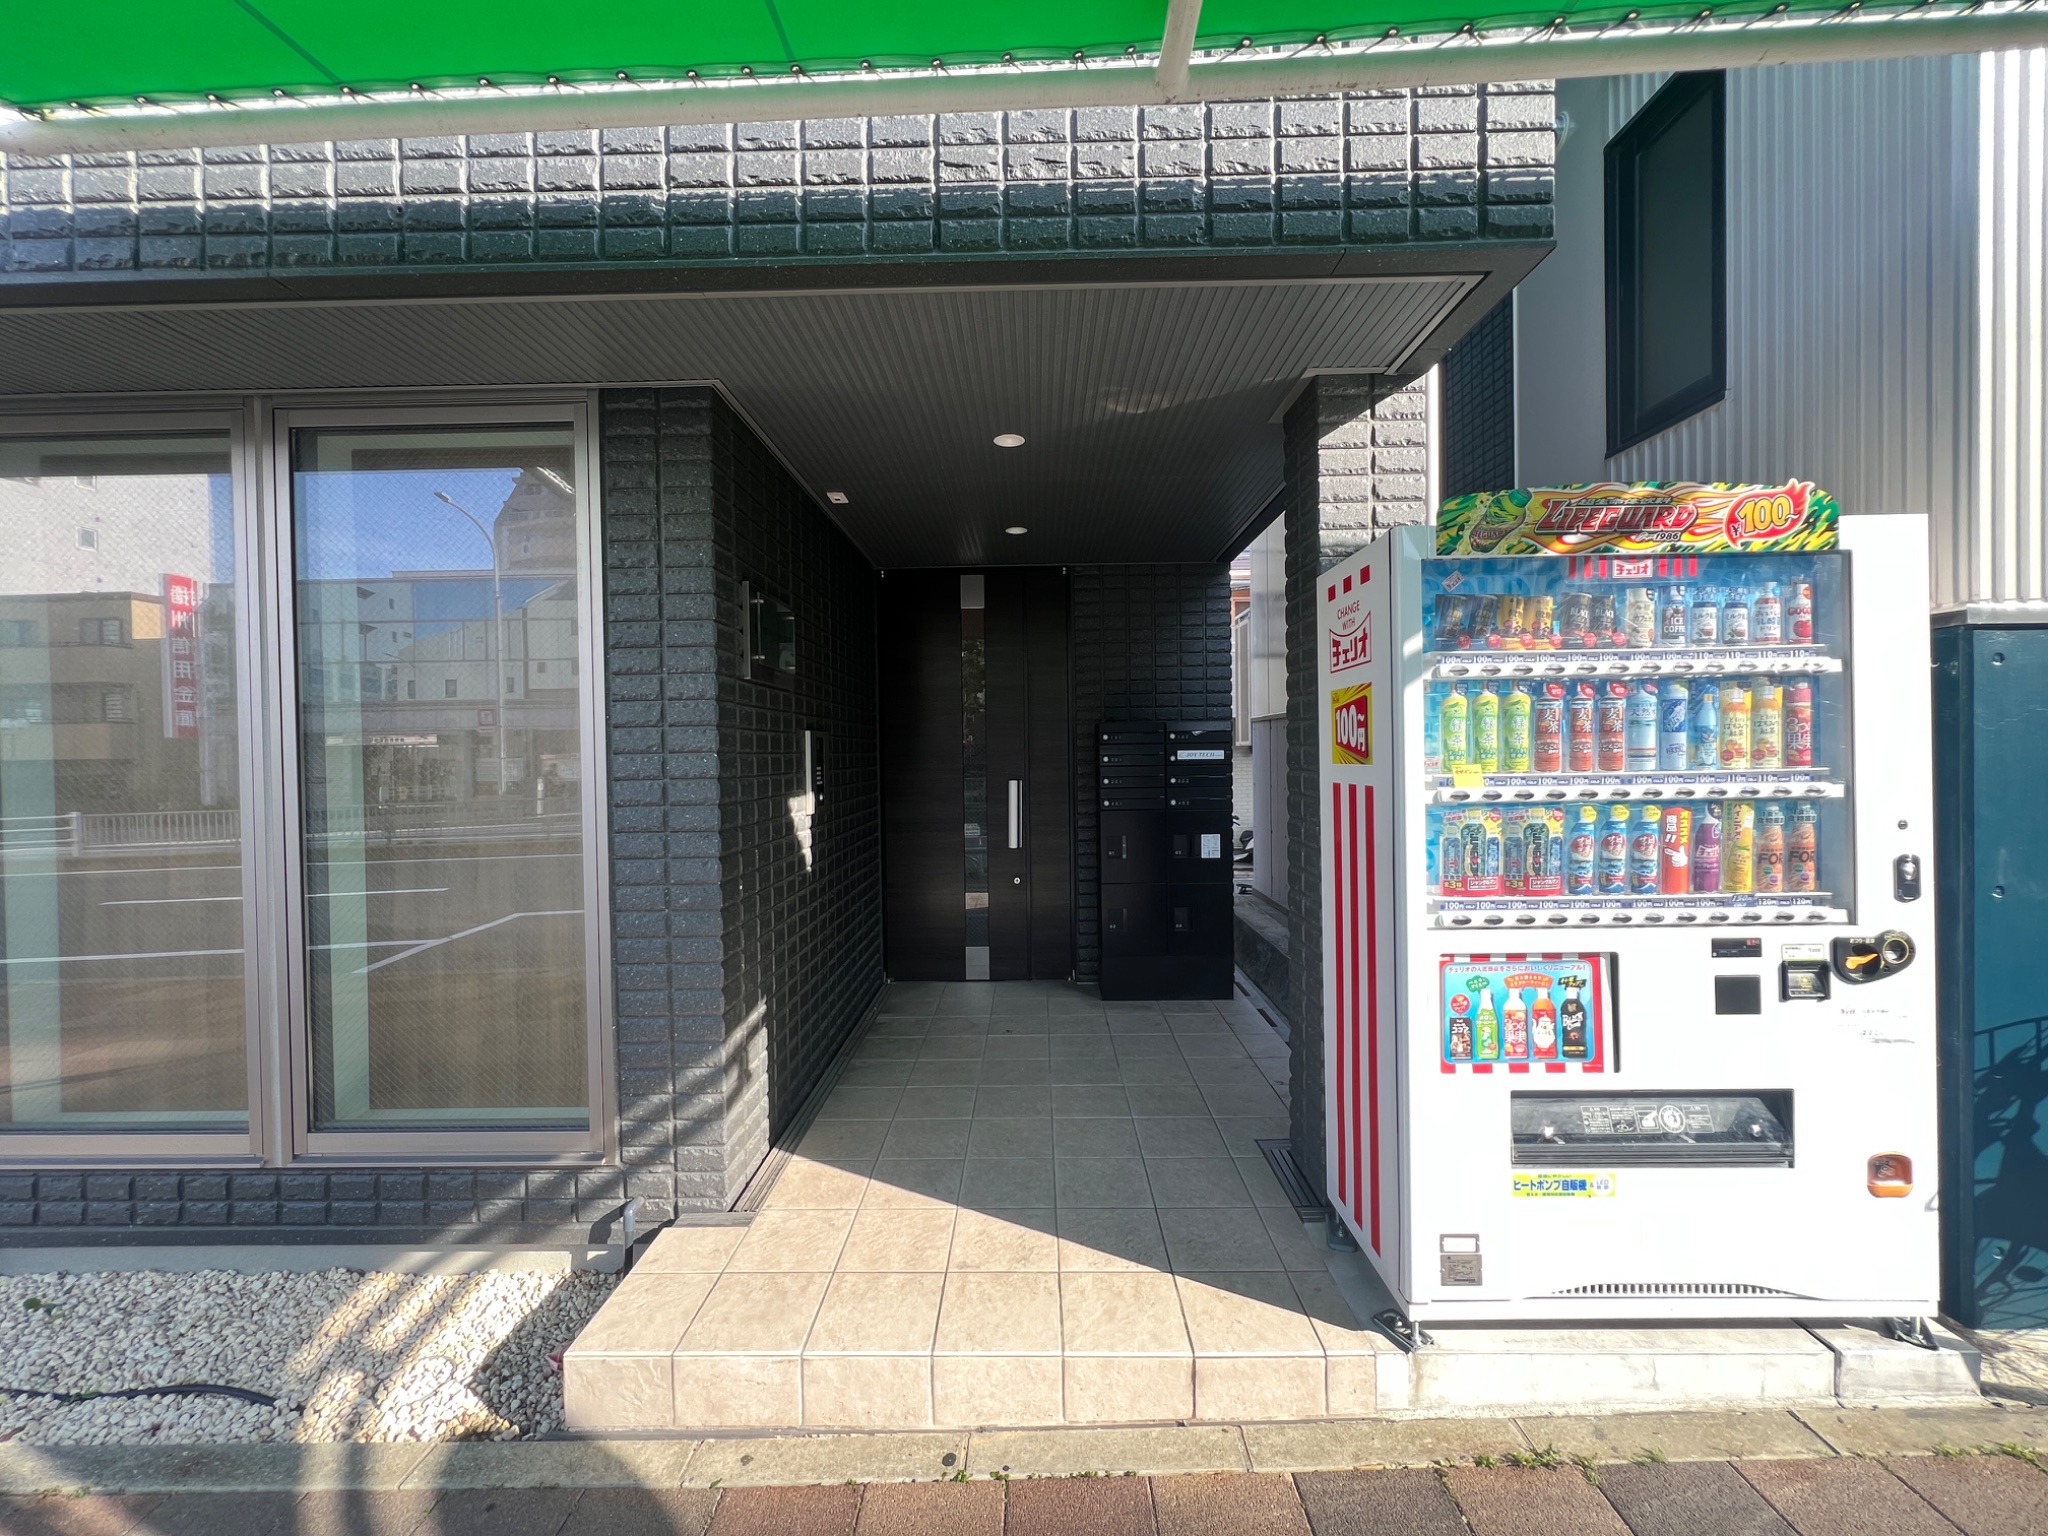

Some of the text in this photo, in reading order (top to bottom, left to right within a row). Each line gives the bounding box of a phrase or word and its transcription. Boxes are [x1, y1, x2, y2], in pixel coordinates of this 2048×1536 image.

[1535, 499, 1698, 534] LIFEGUARD
[1655, 532, 1681, 541] 1986
[1616, 563, 1649, 575] チェリオ
[1337, 599, 1360, 620] CHANGE
[1342, 617, 1355, 631] WITH
[1664, 625, 1686, 633] COFFE
[1332, 626, 1368, 668] チェリオ
[1543, 708, 1559, 733] 麦茶
[1577, 708, 1592, 733] 麦茶
[1608, 707, 1622, 732] 麦茶
[1699, 847, 1719, 856] チェリ
[1508, 901, 1527, 909] 100円
[1504, 1018, 1526, 1031] 3つの
[1504, 1030, 1526, 1044] 果実
[1513, 1179, 1587, 1191] ヒートポンプ自販機
